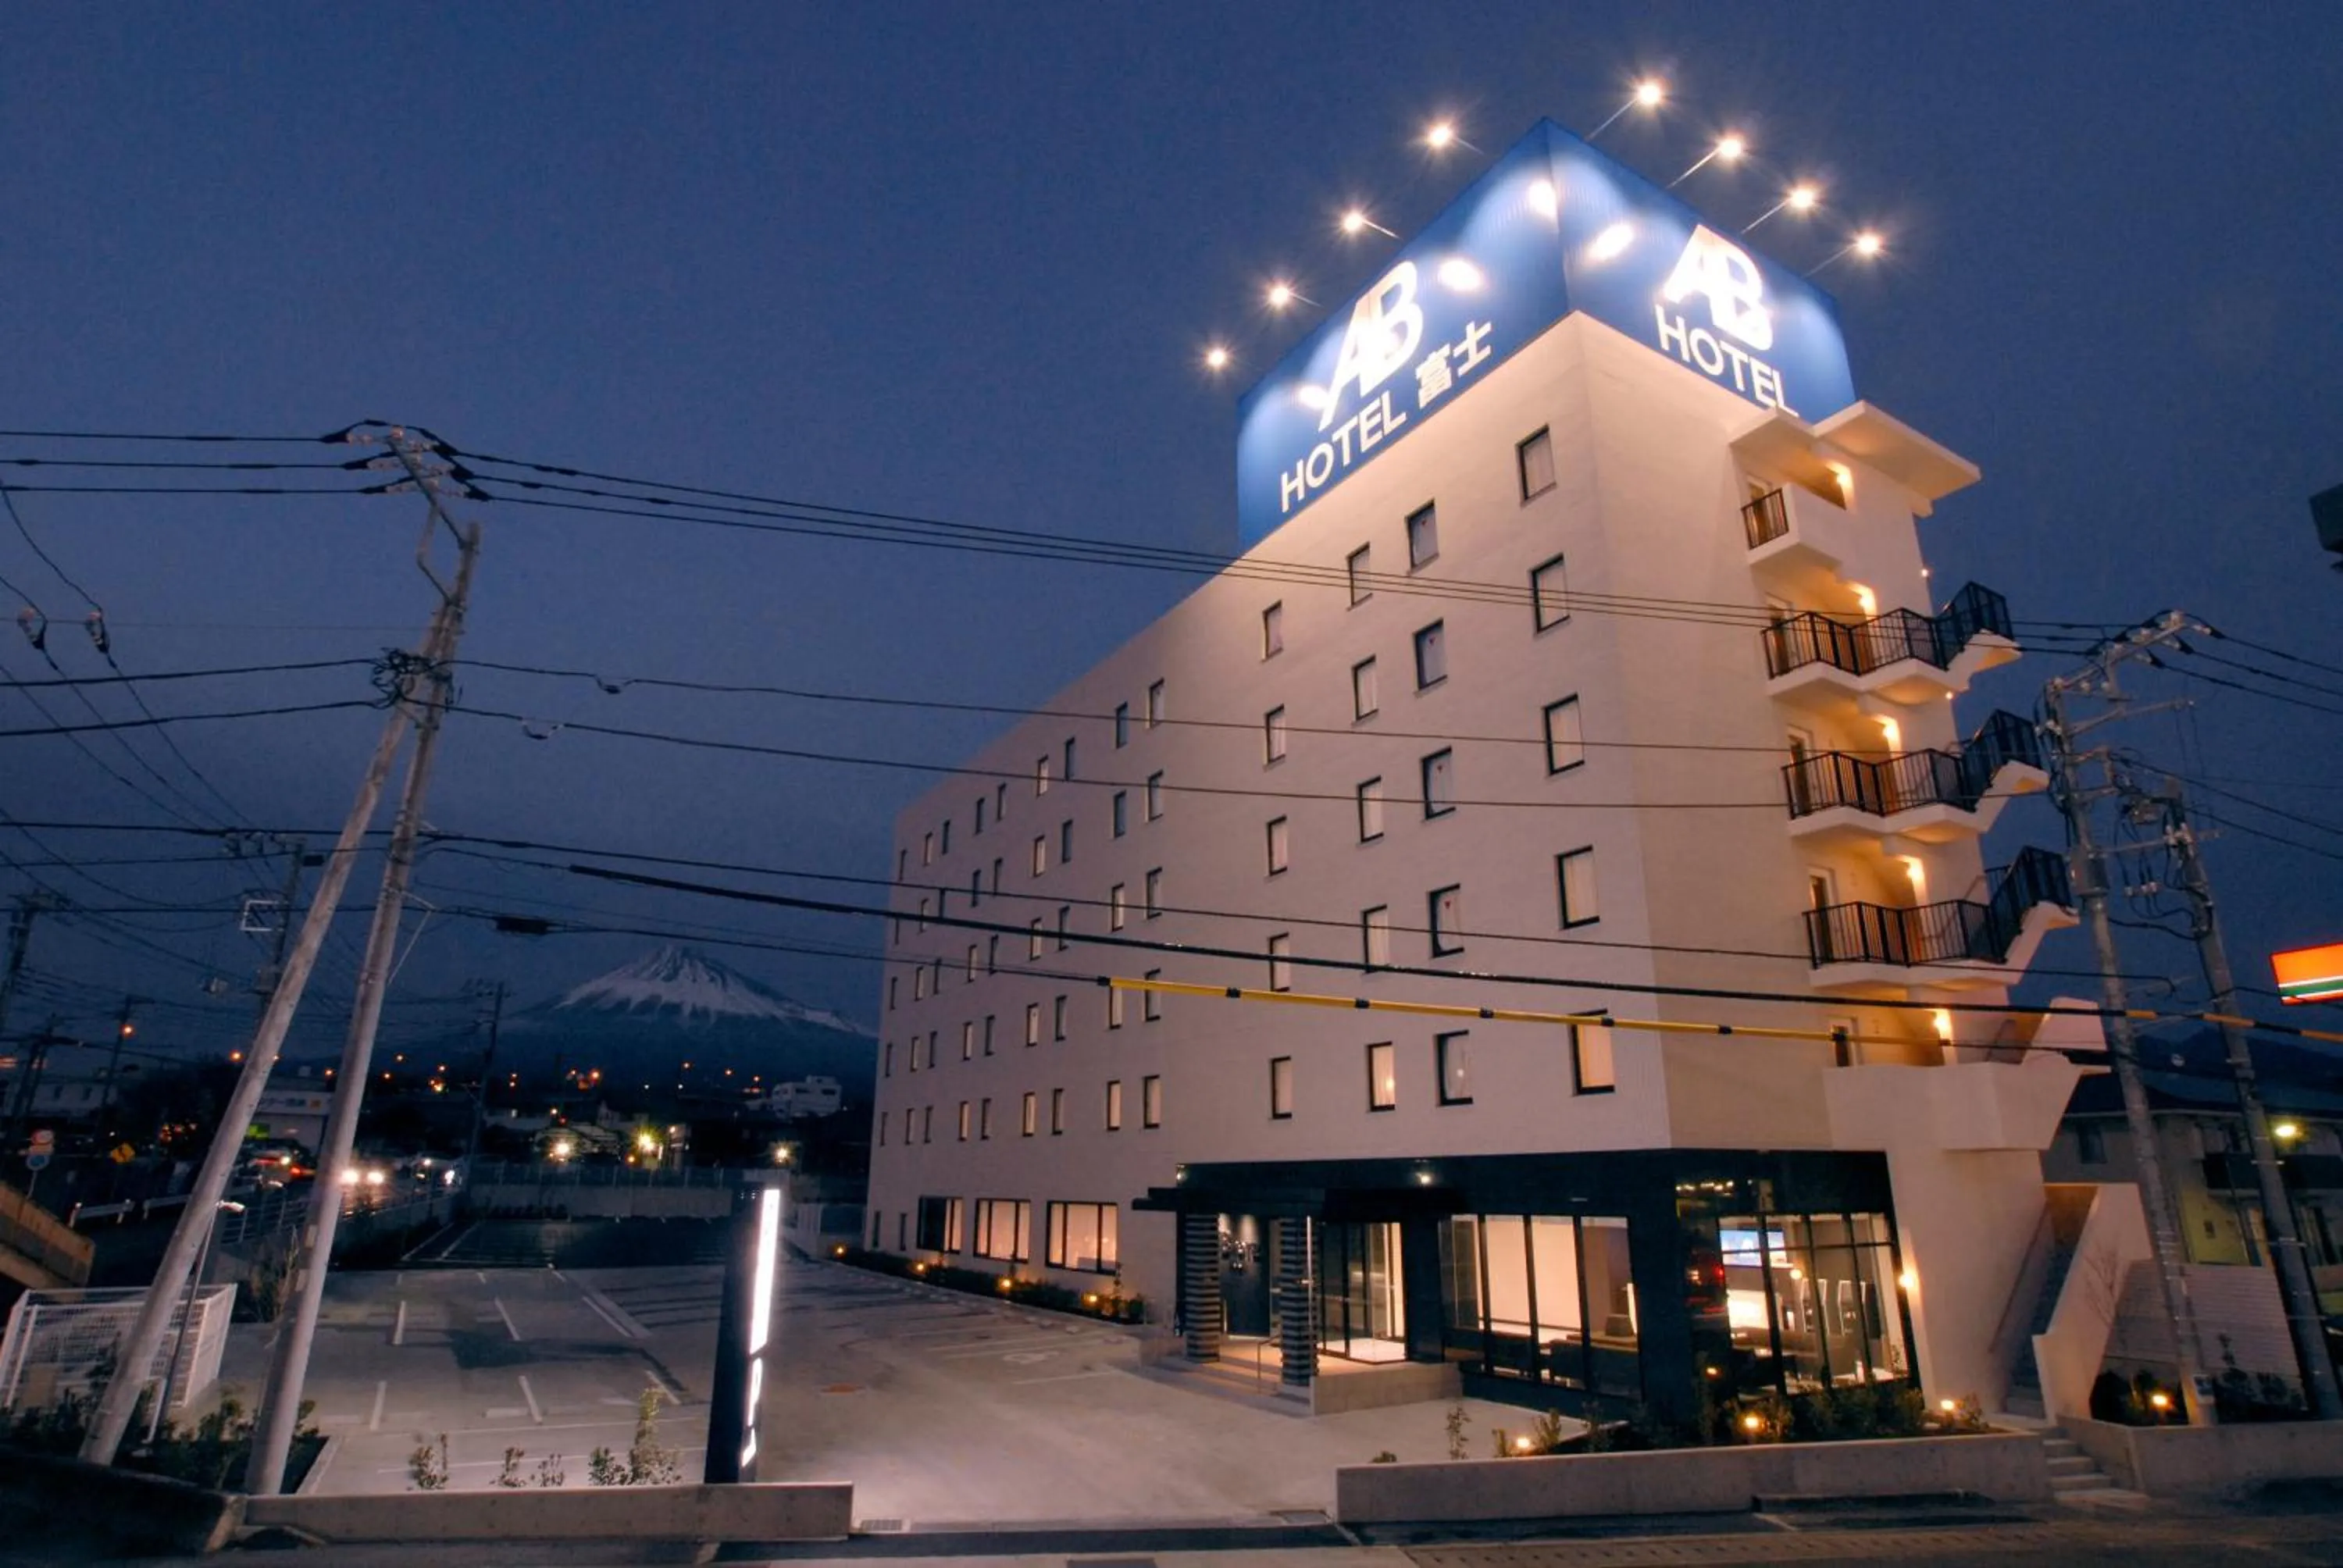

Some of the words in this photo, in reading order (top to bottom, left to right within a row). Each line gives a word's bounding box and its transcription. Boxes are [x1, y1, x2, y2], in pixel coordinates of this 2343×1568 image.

[1318, 260, 1423, 432] AB
[1655, 304, 1799, 417] HOTEL
[1662, 223, 1774, 351] AB
[1281, 390, 1407, 512] HOTEL
[1415, 322, 1491, 409] 富士
